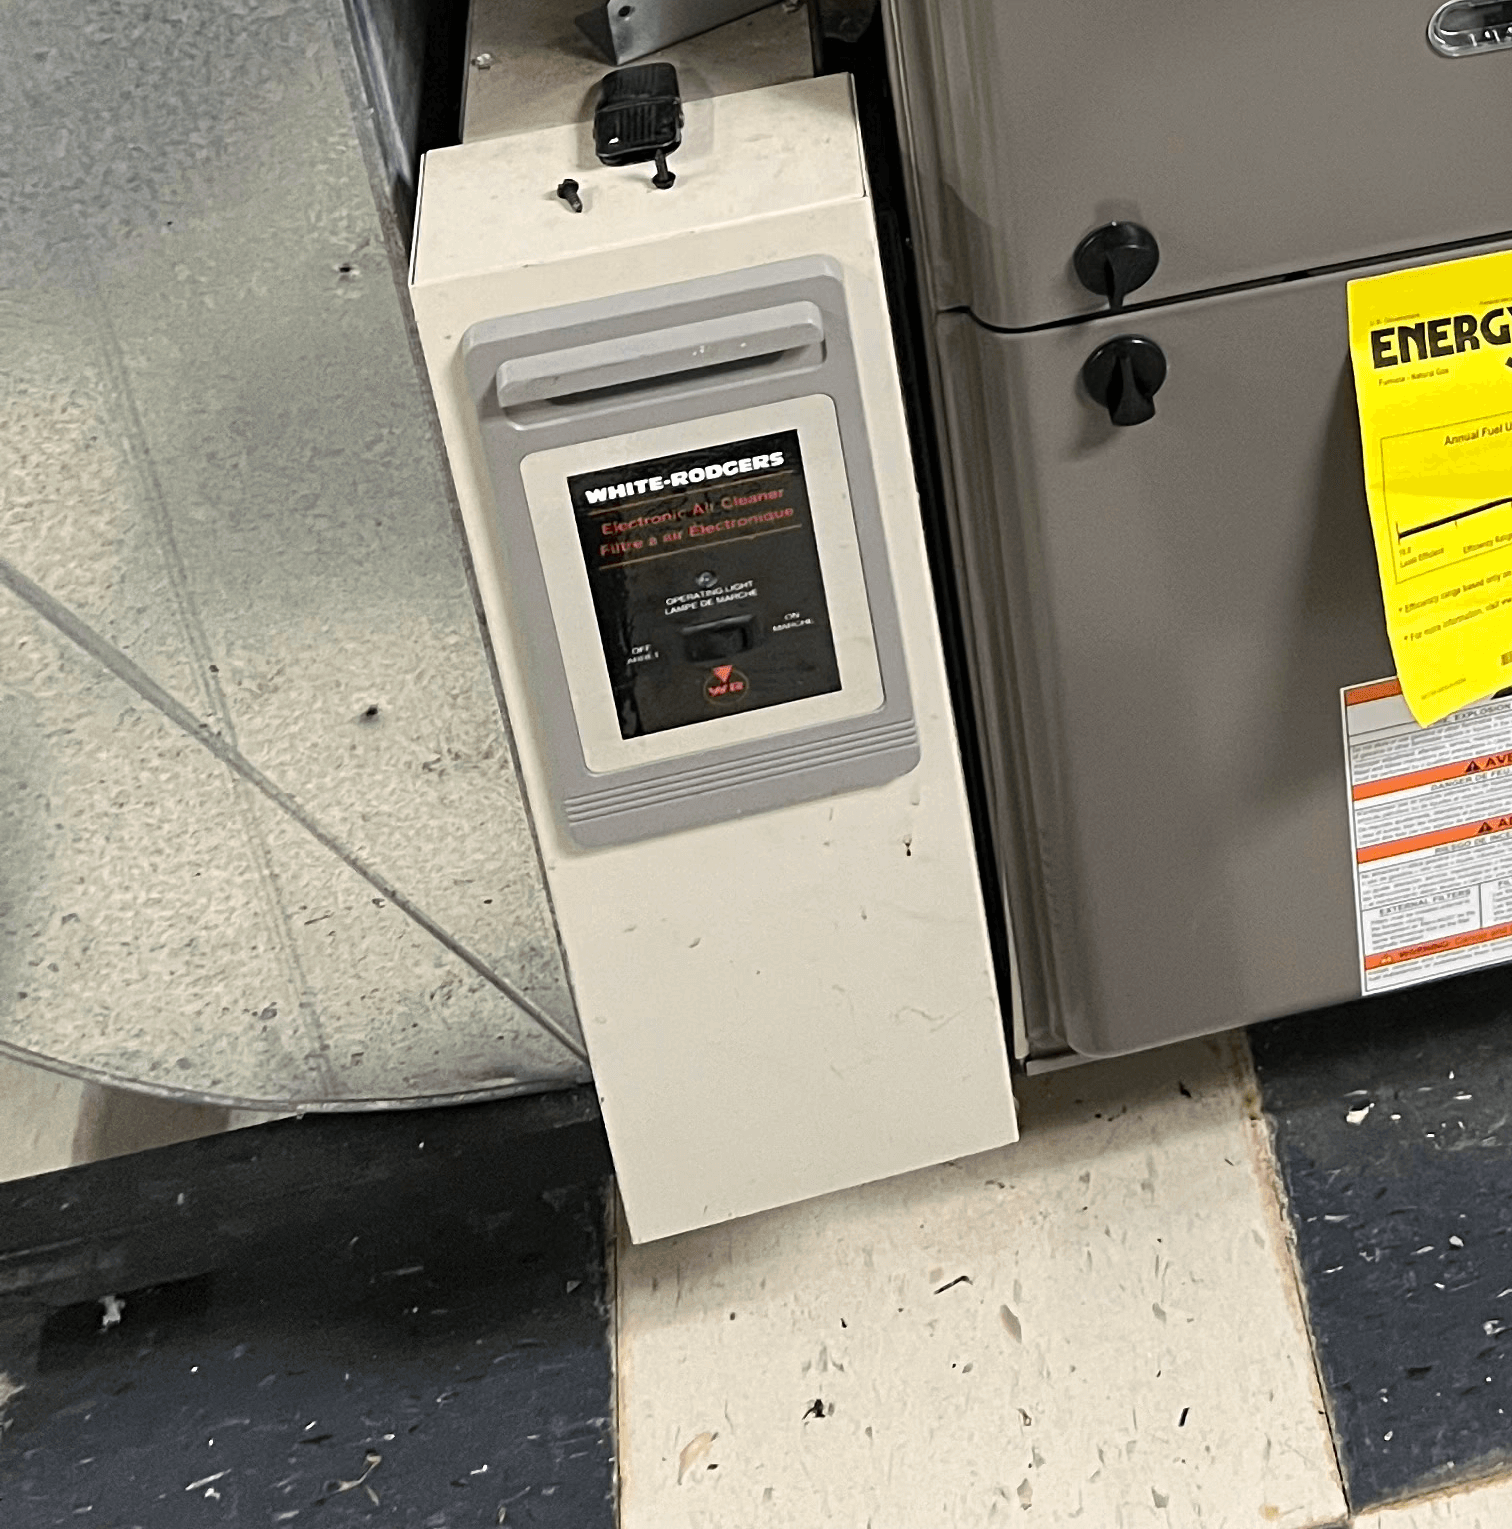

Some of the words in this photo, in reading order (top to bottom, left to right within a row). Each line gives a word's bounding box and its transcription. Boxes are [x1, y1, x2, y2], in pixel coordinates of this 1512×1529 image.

[1411, 370, 1435, 381] Natural
[1443, 430, 1479, 446] Annual
[1481, 424, 1503, 438] Fuel
[584, 451, 785, 505] WHITE-RODGERS
[601, 508, 687, 536] Electronic
[720, 487, 785, 511] Cleaner
[599, 539, 644, 557] Filtre
[664, 601, 698, 616] LAMPE
[700, 597, 715, 607] DE
[715, 587, 758, 604] MARCHE
[665, 586, 724, 606] OPERATING
[725, 579, 754, 593] LIGHT
[784, 611, 801, 621] ON
[631, 643, 651, 655] OFF
[1454, 701, 1511, 722] EXPLOSION
[1430, 775, 1473, 792] DANGER
[1474, 772, 1490, 784] DE
[1379, 899, 1428, 917] EXTERNAL
[1432, 888, 1471, 903] FILTERS
